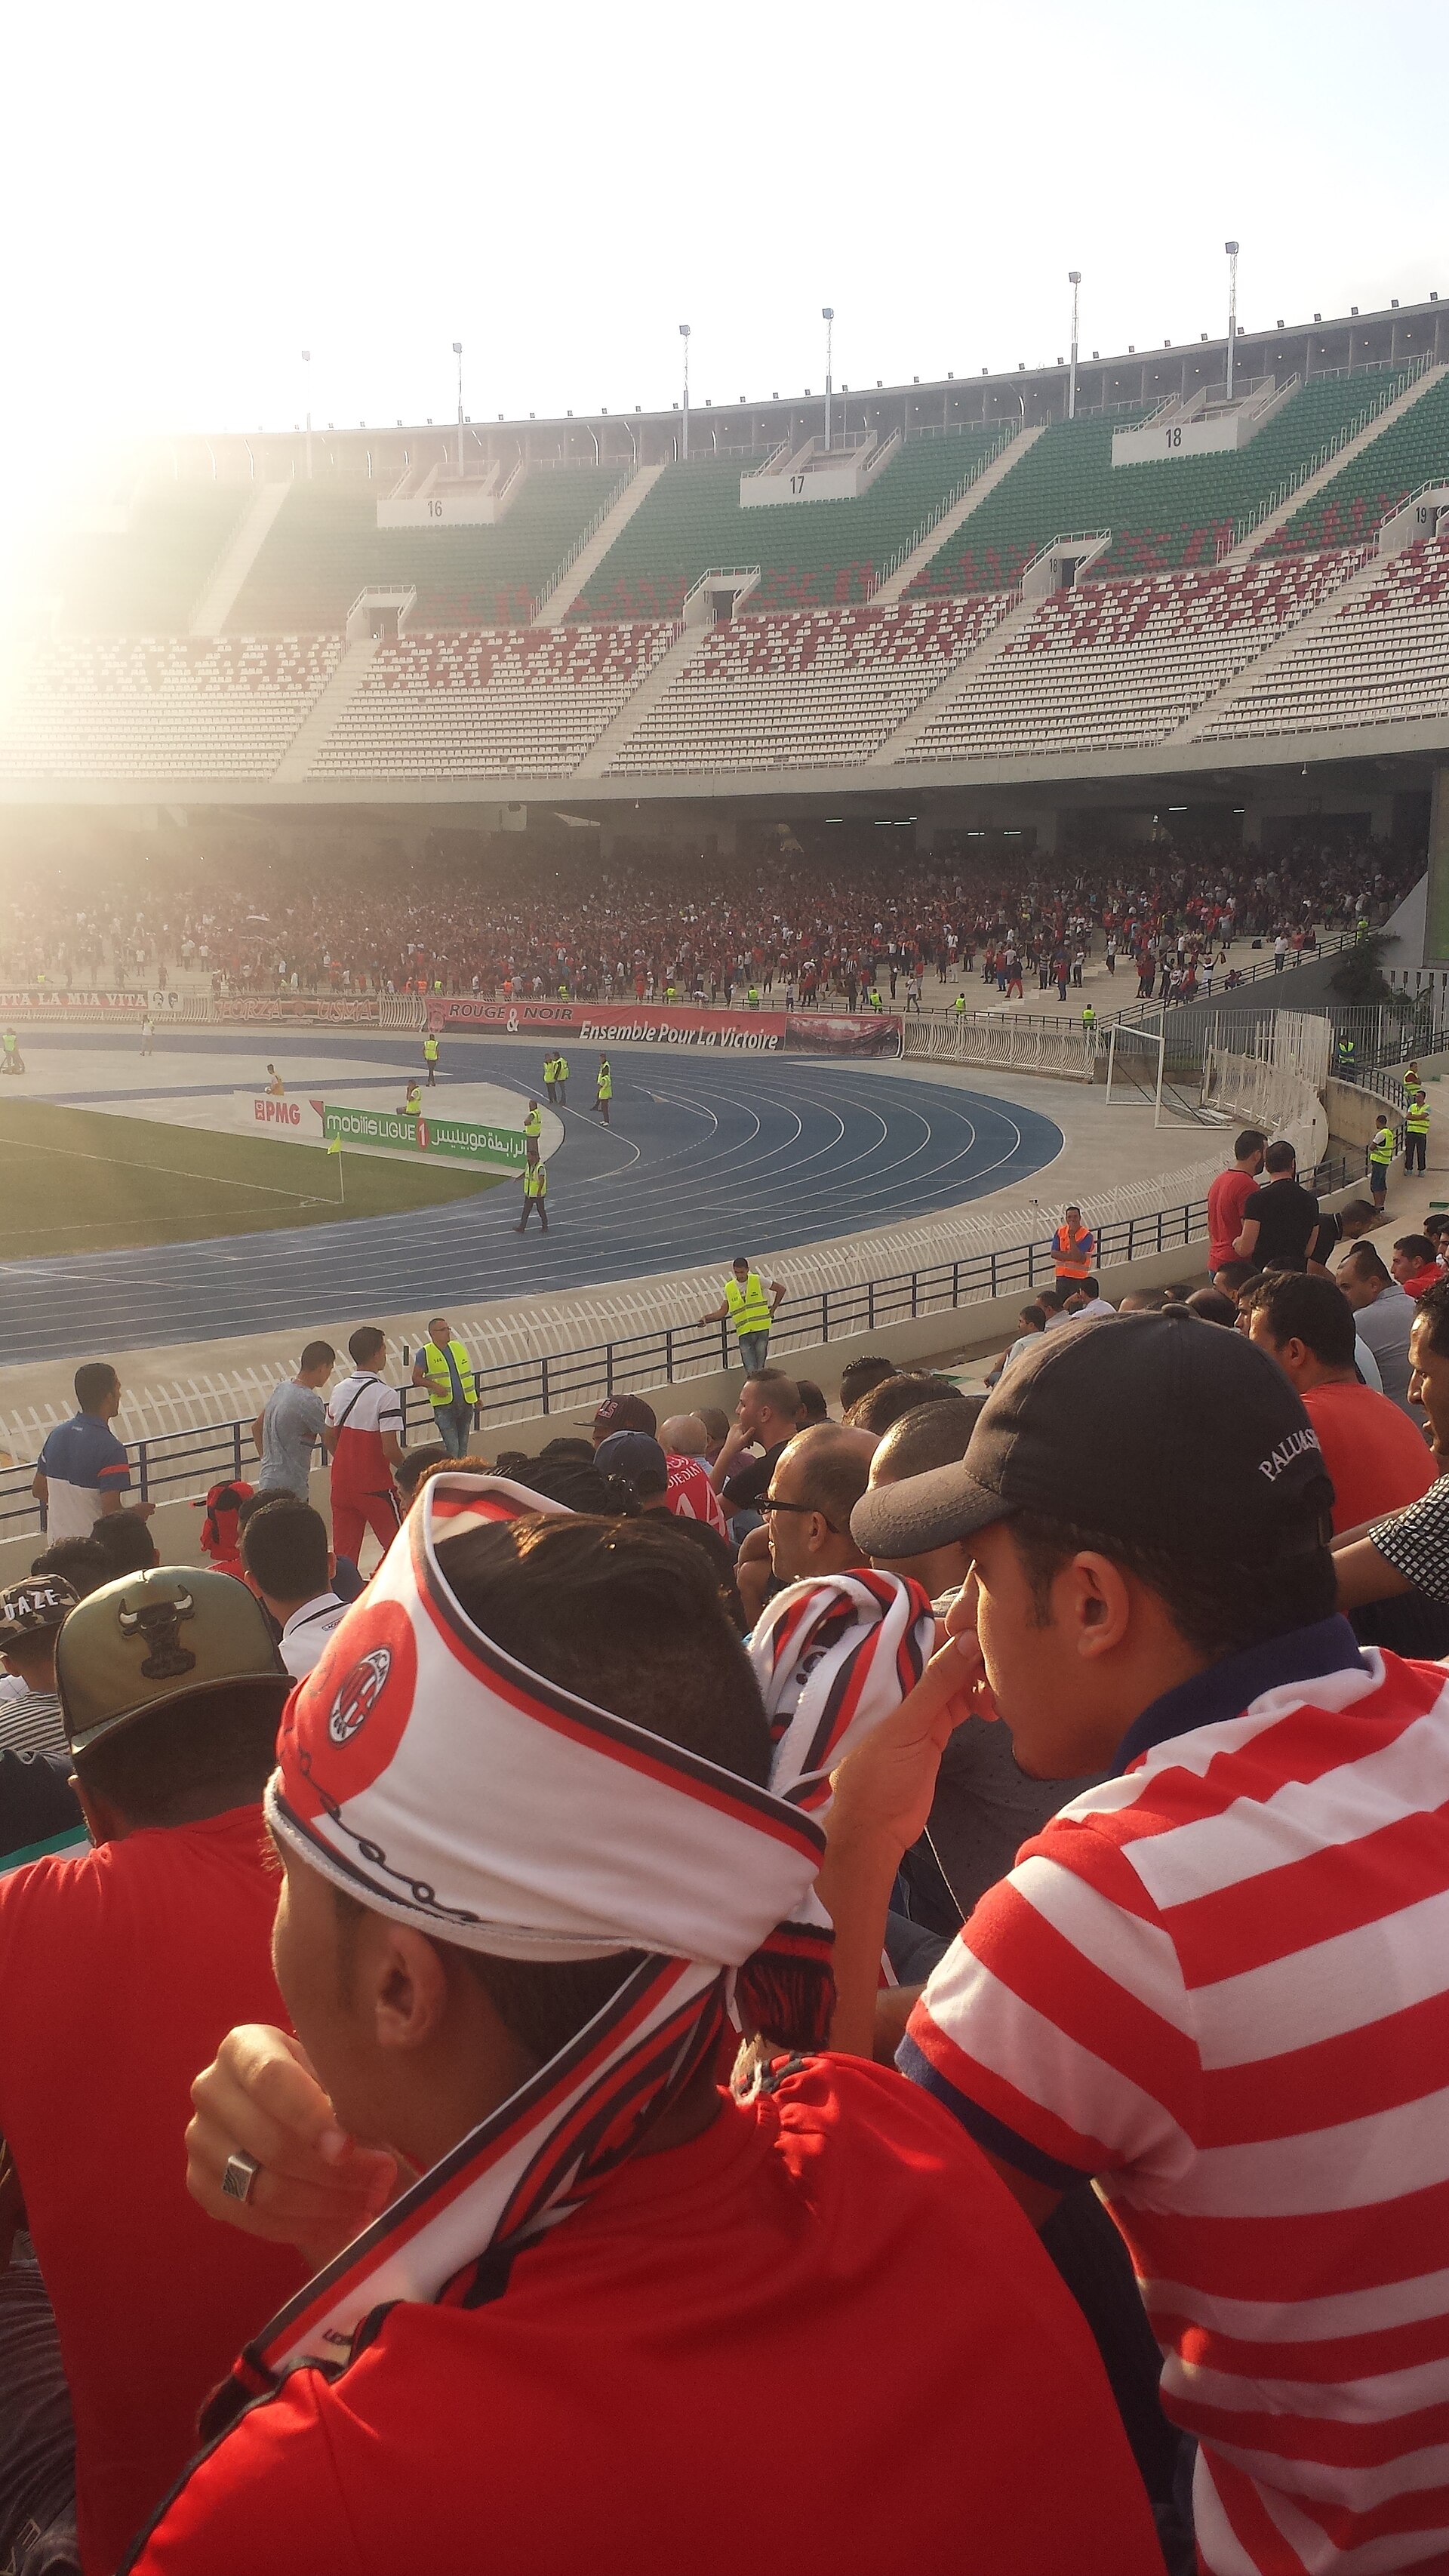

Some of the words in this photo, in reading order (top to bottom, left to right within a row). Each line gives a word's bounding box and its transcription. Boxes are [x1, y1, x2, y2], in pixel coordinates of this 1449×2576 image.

[1165, 427, 1182, 448] 18
[790, 475, 804, 494] 17
[427, 500, 442, 517] 16
[1416, 506, 1427, 524] 19
[1049, 558, 1057, 573] 18
[38, 993, 62, 1006] LA
[67, 993, 101, 1006] MIA
[106, 993, 147, 1007] VITA
[217, 998, 283, 1020] FORZA
[317, 998, 372, 1022] USMA
[449, 1004, 506, 1019] ROUGE
[506, 1008, 519, 1032] &
[524, 1007, 574, 1020] NOIR
[579, 1020, 658, 1042] Ensemble
[657, 1023, 697, 1045] Pour
[697, 1025, 717, 1046] La
[720, 1026, 778, 1050] Victoire
[327, 1115, 377, 1136] mobilis
[379, 1121, 416, 1141] LIGUE
